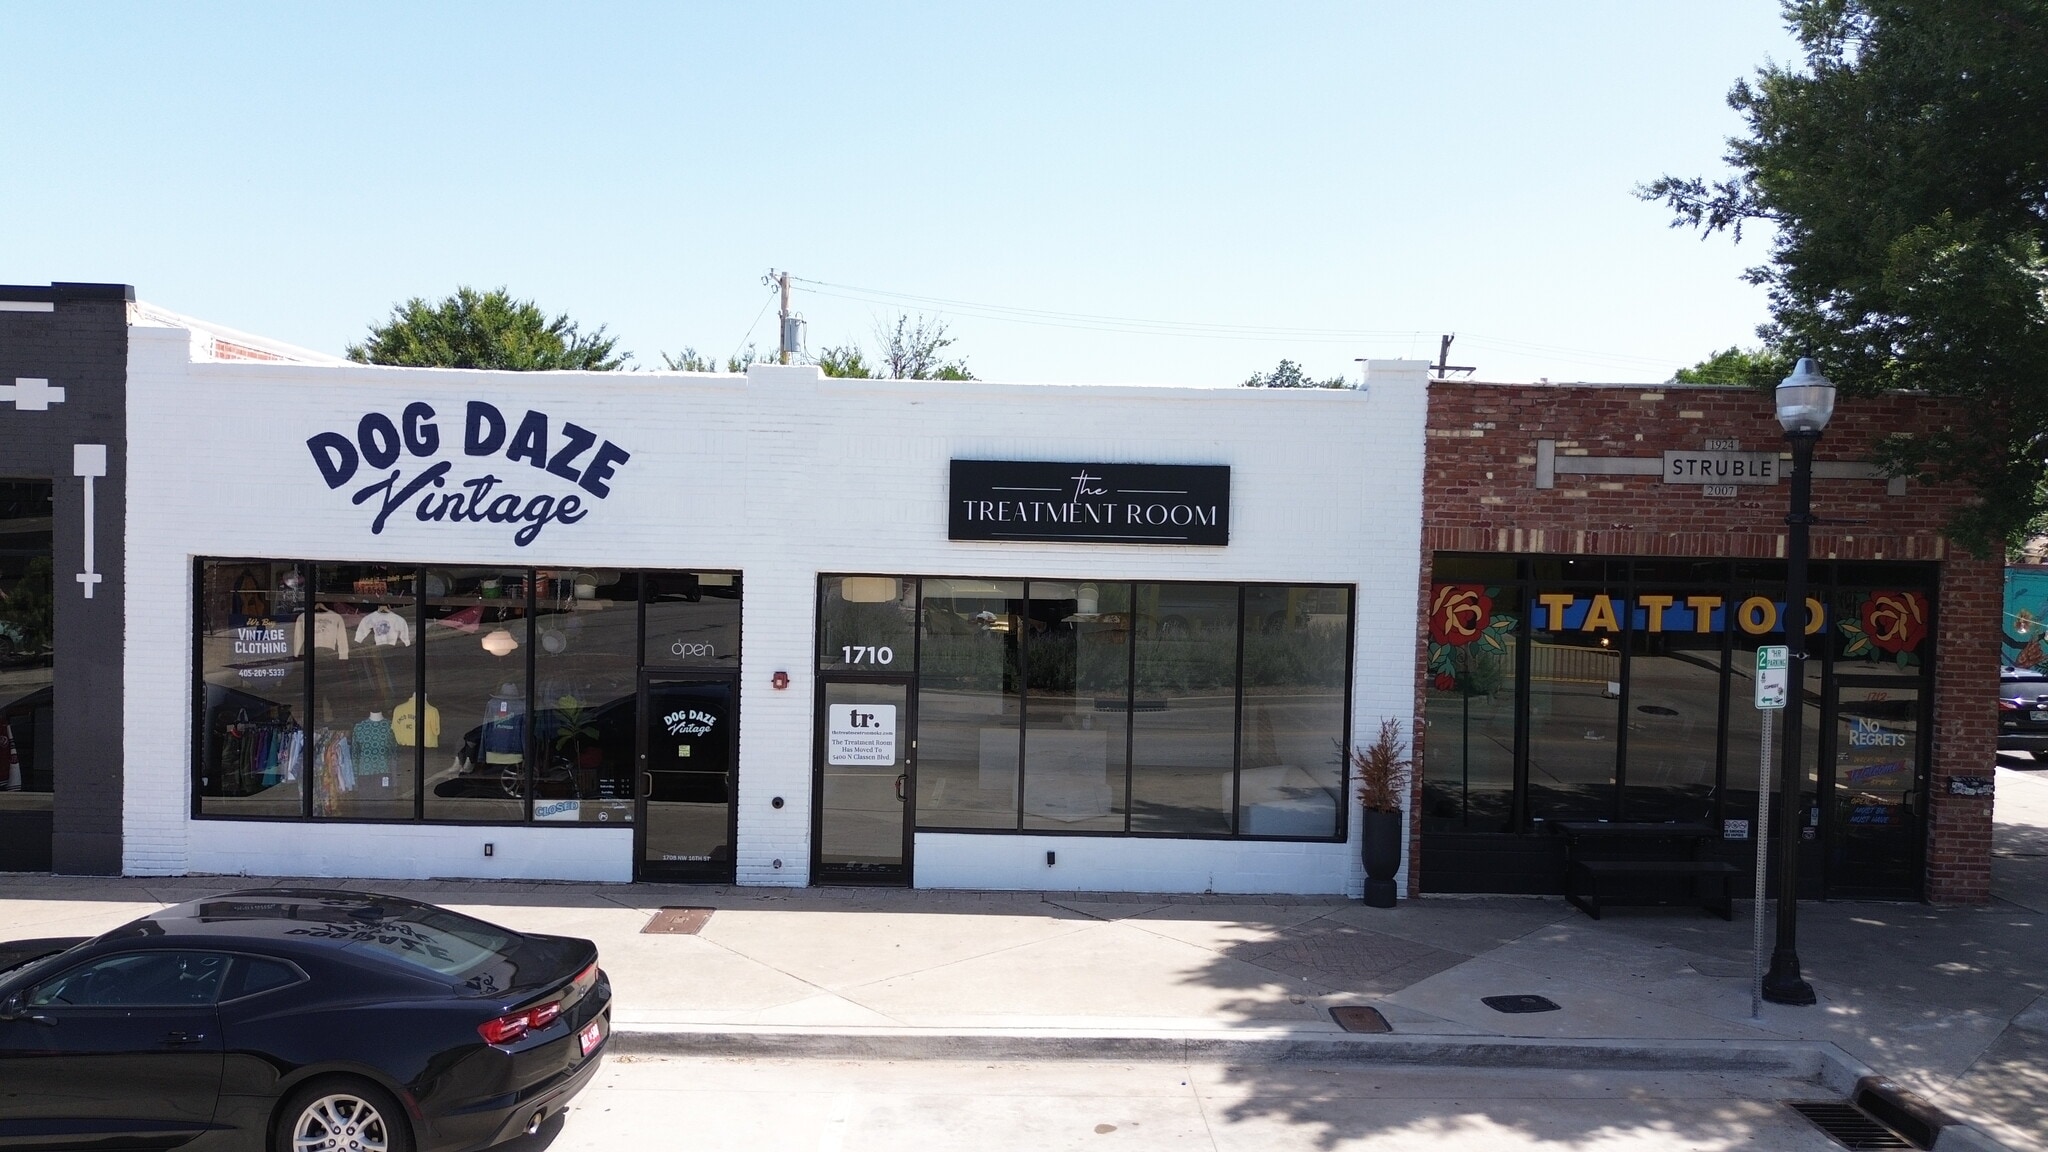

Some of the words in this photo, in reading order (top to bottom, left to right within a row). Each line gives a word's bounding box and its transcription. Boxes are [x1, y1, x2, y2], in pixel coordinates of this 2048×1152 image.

[306, 401, 440, 489] DOG
[464, 401, 631, 499] DAZE
[1711, 441, 1734, 449] 1924
[1673, 459, 1771, 477] STRUBLE
[1071, 469, 1108, 503] the
[1708, 486, 1734, 495] 2007
[352, 461, 588, 547] Vintage
[963, 500, 1117, 524] TREATMENT
[1127, 504, 1216, 526] ROOM
[246, 618, 260, 626] We
[262, 618, 276, 628] Buy
[238, 628, 285, 641] VINTAGE
[235, 641, 287, 654] CLOTHING
[671, 639, 714, 659] open
[842, 645, 893, 665] 1710
[1759, 651, 1767, 667] 2
[238, 669, 285, 677] 405-209-5333
[663, 710, 686, 725] DOG
[689, 710, 717, 726] DAZE
[849, 709, 880, 728] tr.
[1859, 718, 1880, 733] No
[667, 721, 712, 737] Vintage
[1849, 730, 1906, 746] REGRETS
[535, 801, 579, 817] CLOSED
